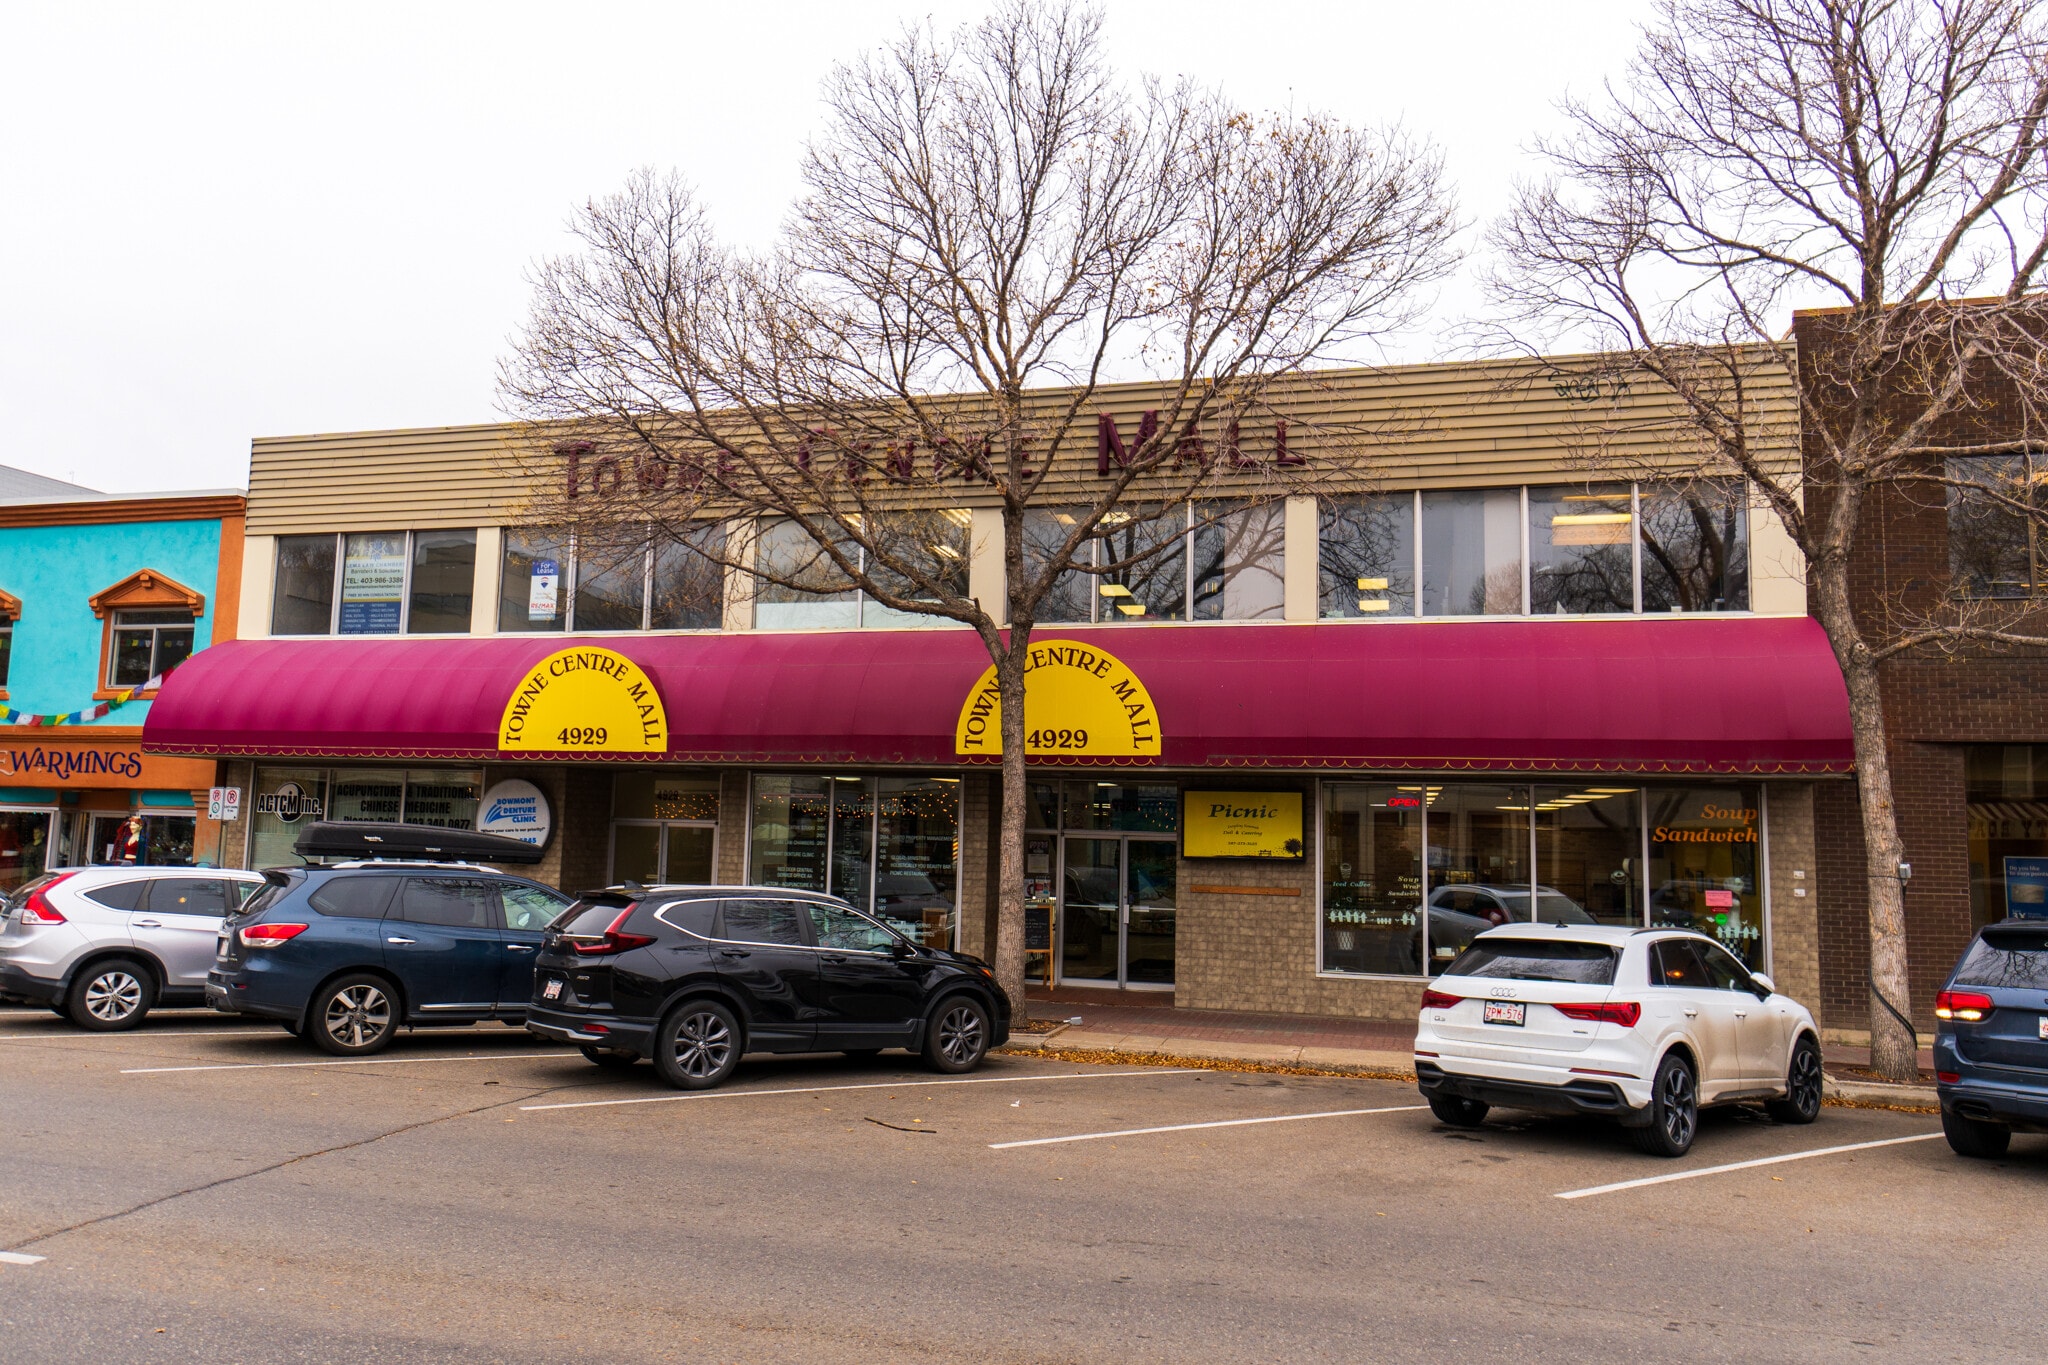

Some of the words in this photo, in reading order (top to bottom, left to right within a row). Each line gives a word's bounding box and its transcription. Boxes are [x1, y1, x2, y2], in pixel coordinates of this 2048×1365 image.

[1098, 410, 1306, 476] MALL
[505, 672, 549, 745] TOWNE
[550, 653, 629, 682] CENTRE
[626, 681, 661, 746] MALL
[964, 673, 1001, 749] TOWN
[1110, 678, 1153, 750] MALL
[557, 727, 608, 745] 4929
[1027, 729, 1089, 749] 4929
[337, 784, 401, 798] ACUPUNCTURE
[416, 786, 475, 799] TRADITIONAL
[360, 800, 399, 813] CHINESE
[405, 801, 451, 814] MEDICINE
[496, 797, 536, 805] BOWMONT
[1387, 797, 1421, 807] OPEN
[503, 806, 537, 814] DENTURE
[1208, 804, 1279, 819] Picnic
[1701, 804, 1759, 825] Soup
[1653, 826, 1759, 843] Sandwich
[1397, 875, 1420, 884] Soup
[1485, 1006, 1523, 1021] ZPM-576
